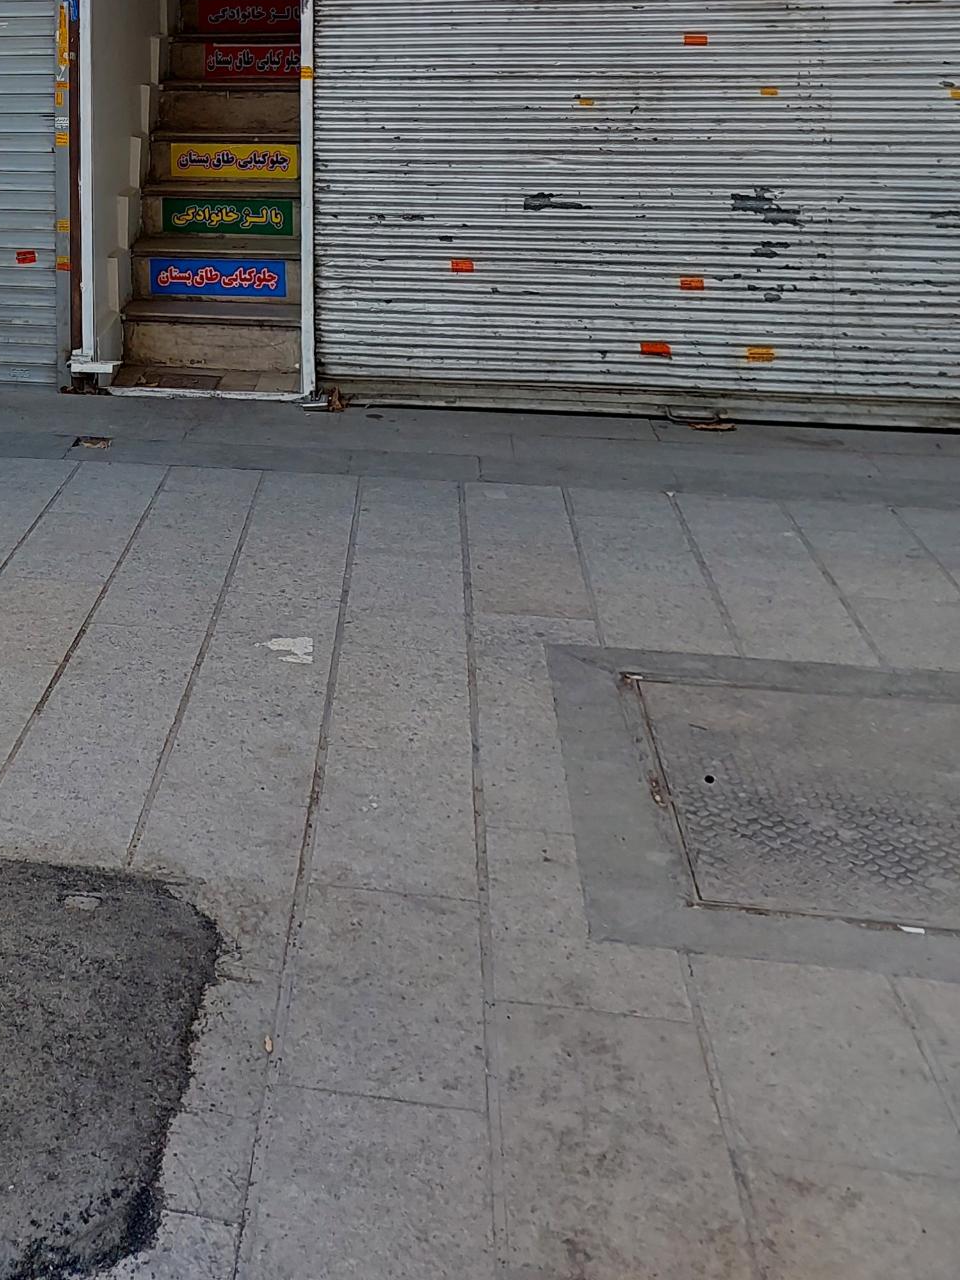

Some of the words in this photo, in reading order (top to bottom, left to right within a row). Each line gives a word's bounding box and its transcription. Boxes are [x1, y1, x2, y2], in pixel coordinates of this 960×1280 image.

[206, 49, 233, 72] بستان
[177, 150, 211, 170] بستان
[210, 150, 237, 170] طاق
[269, 206, 284, 230] با
[157, 266, 193, 287] بستان
[193, 266, 221, 288] طاق
